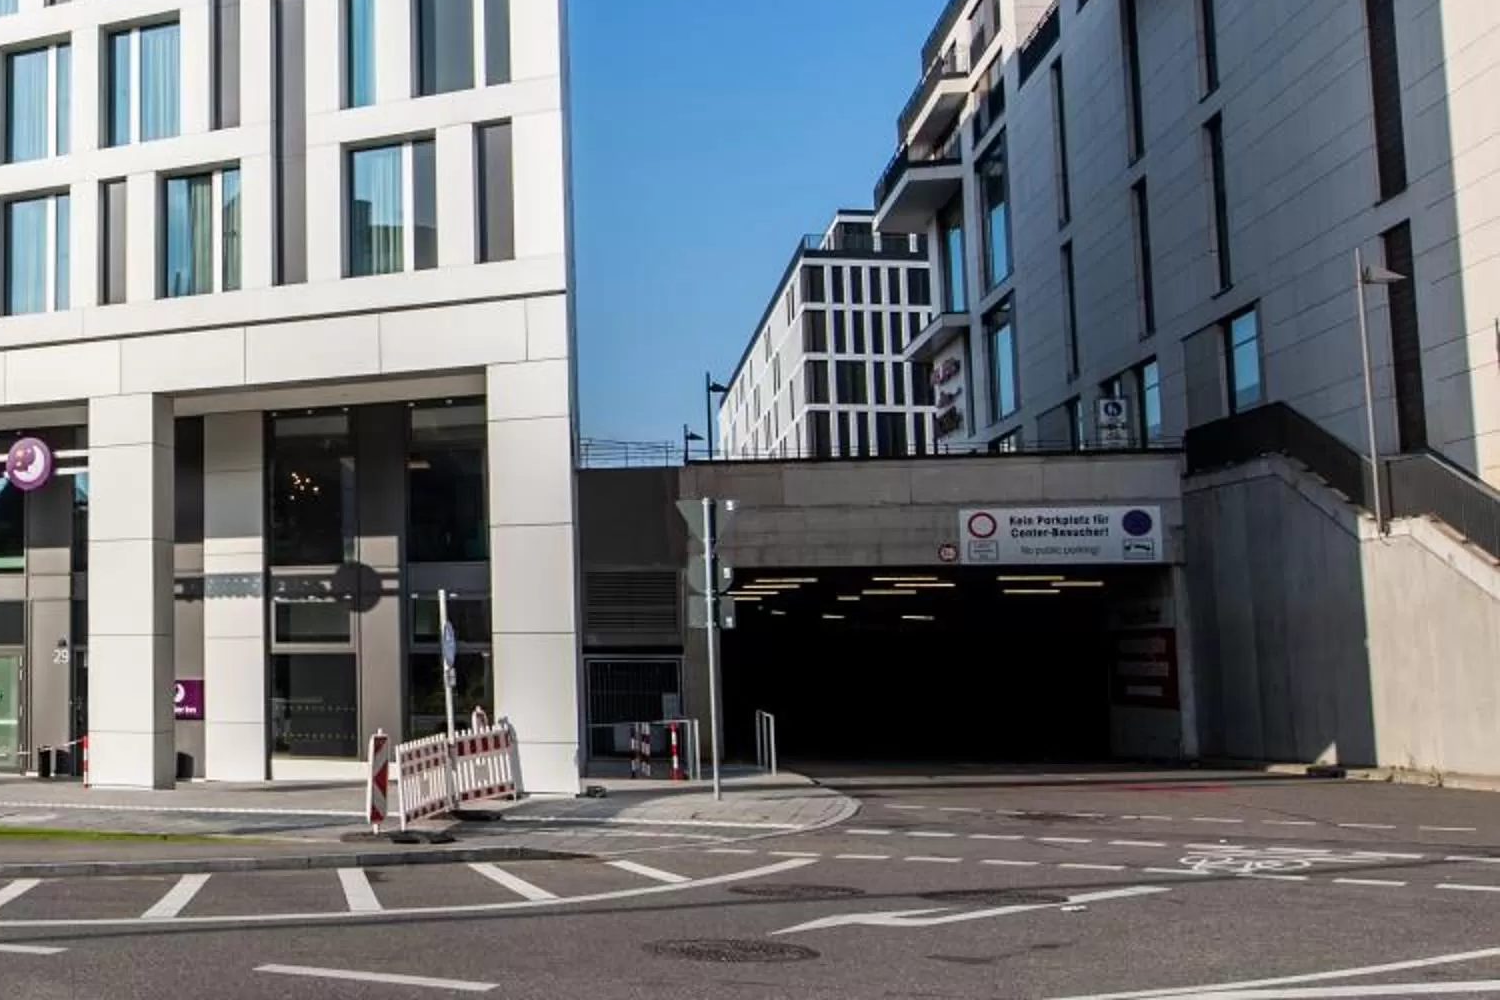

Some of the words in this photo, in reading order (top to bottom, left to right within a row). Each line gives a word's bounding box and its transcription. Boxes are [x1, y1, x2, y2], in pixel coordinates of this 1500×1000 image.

[1009, 515, 1033, 526] Kein
[1037, 514, 1090, 528] Parkplatz
[1092, 513, 1109, 525] für
[53, 649, 69, 665] 29
